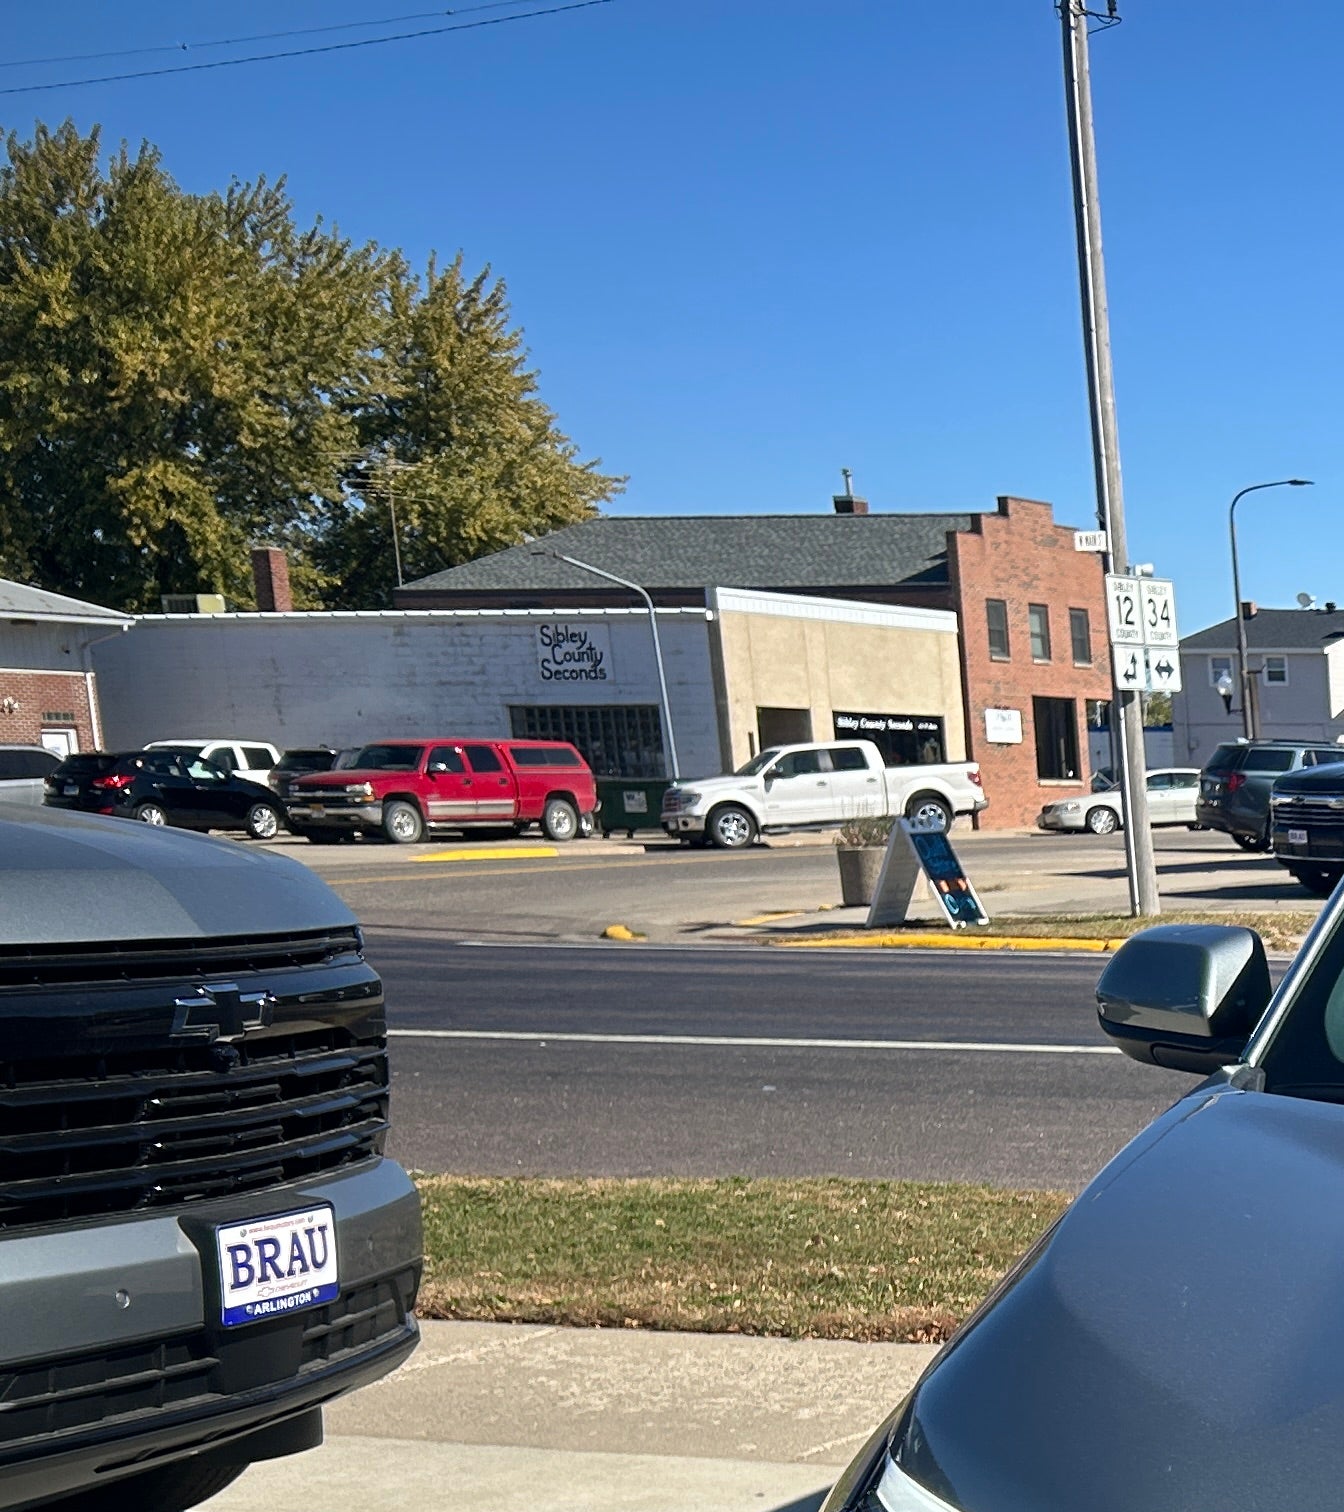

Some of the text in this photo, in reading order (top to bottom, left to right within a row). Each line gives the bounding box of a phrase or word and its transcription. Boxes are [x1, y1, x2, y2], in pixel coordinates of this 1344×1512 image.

[1116, 594, 1135, 626] 12
[1147, 598, 1170, 628] 34
[540, 625, 587, 650] Sibley
[551, 641, 604, 668] County
[541, 658, 607, 681] Seconds
[226, 1223, 330, 1292] BRAU
[254, 1291, 312, 1316] ARLINGTON
